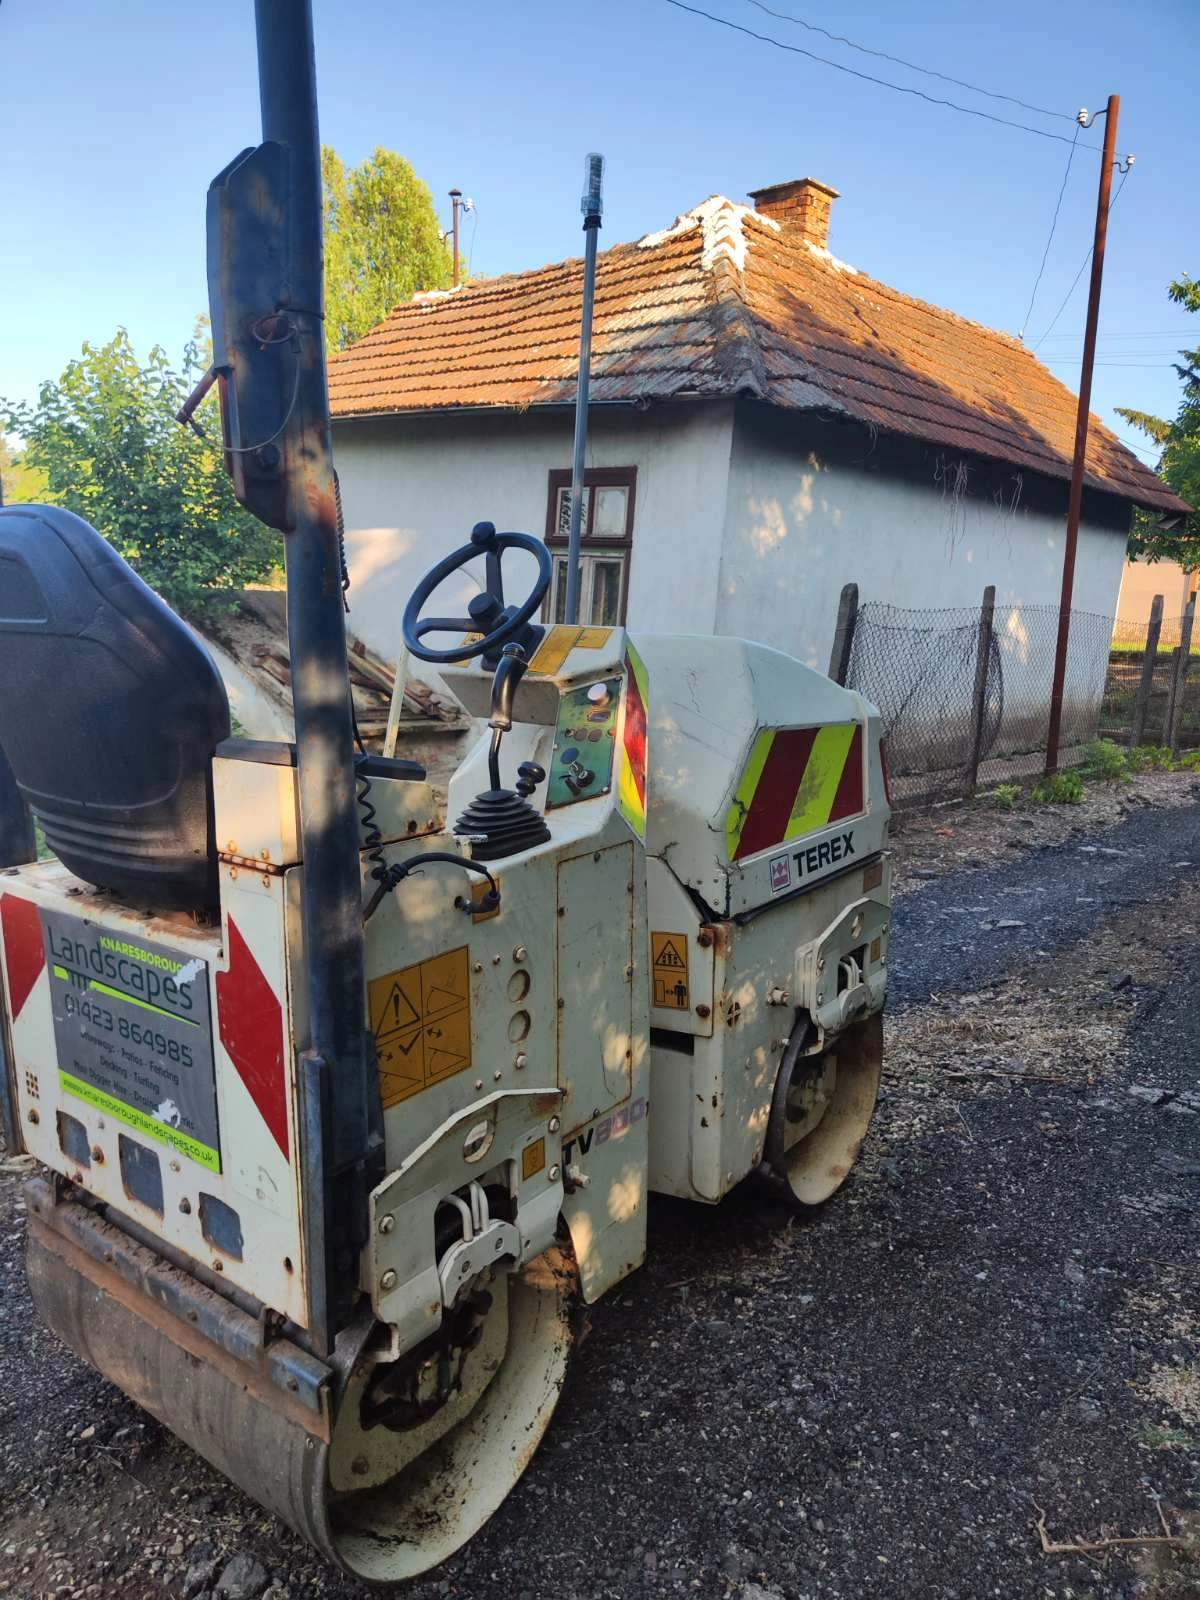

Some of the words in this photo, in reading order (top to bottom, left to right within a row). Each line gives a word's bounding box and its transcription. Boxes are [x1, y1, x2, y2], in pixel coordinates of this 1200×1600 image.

[792, 830, 855, 877] TEREX
[47, 925, 193, 1010] Landscapes
[100, 936, 183, 975] KNARESBOROUG
[65, 993, 114, 1031] 01423
[118, 1016, 193, 1067] 864985
[562, 1096, 649, 1166] TV800
